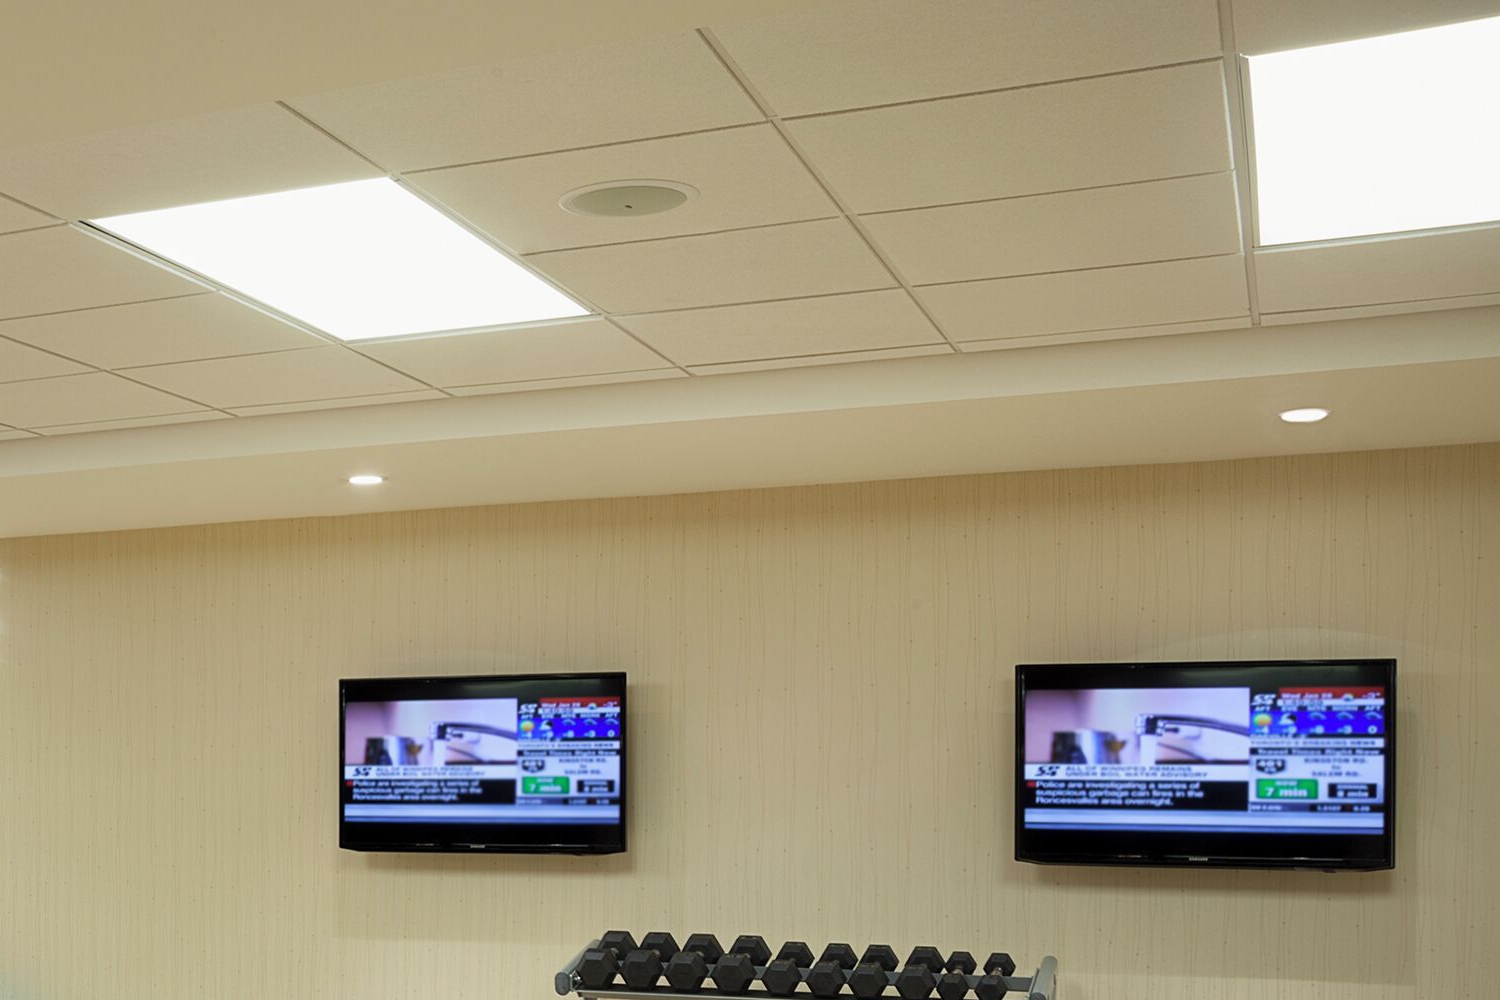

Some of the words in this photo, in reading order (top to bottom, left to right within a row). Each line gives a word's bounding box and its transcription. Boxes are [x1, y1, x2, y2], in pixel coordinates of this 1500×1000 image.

[1085, 782, 1146, 790] investigating
[1036, 790, 1086, 798] suspicious
[1089, 790, 1129, 799] garbage
[1187, 790, 1204, 798] the
[1279, 787, 1308, 797] min
[1036, 797, 1099, 805] Roncesvalles
